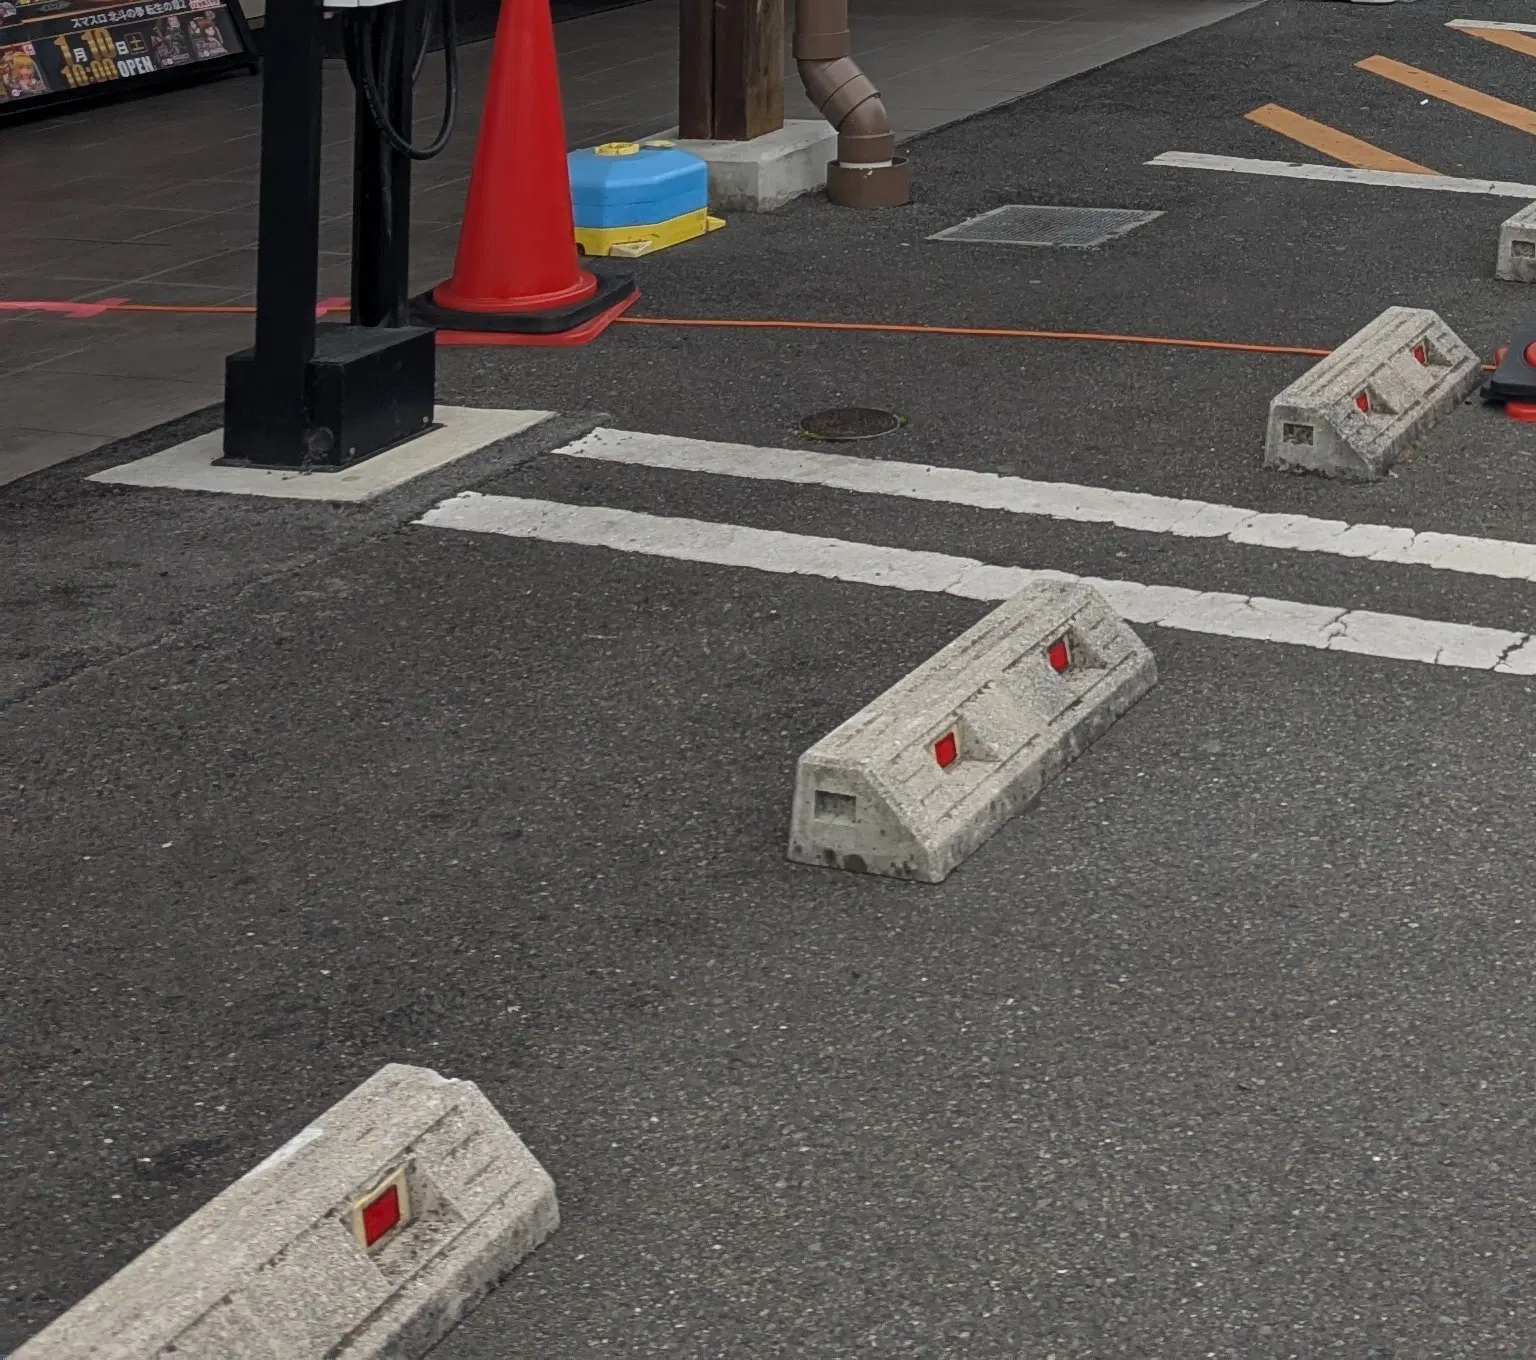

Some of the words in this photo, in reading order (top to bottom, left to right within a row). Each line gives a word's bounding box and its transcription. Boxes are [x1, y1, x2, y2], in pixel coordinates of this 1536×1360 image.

[71, 15, 108, 29] スマスロ
[117, 56, 155, 78] OPEN
